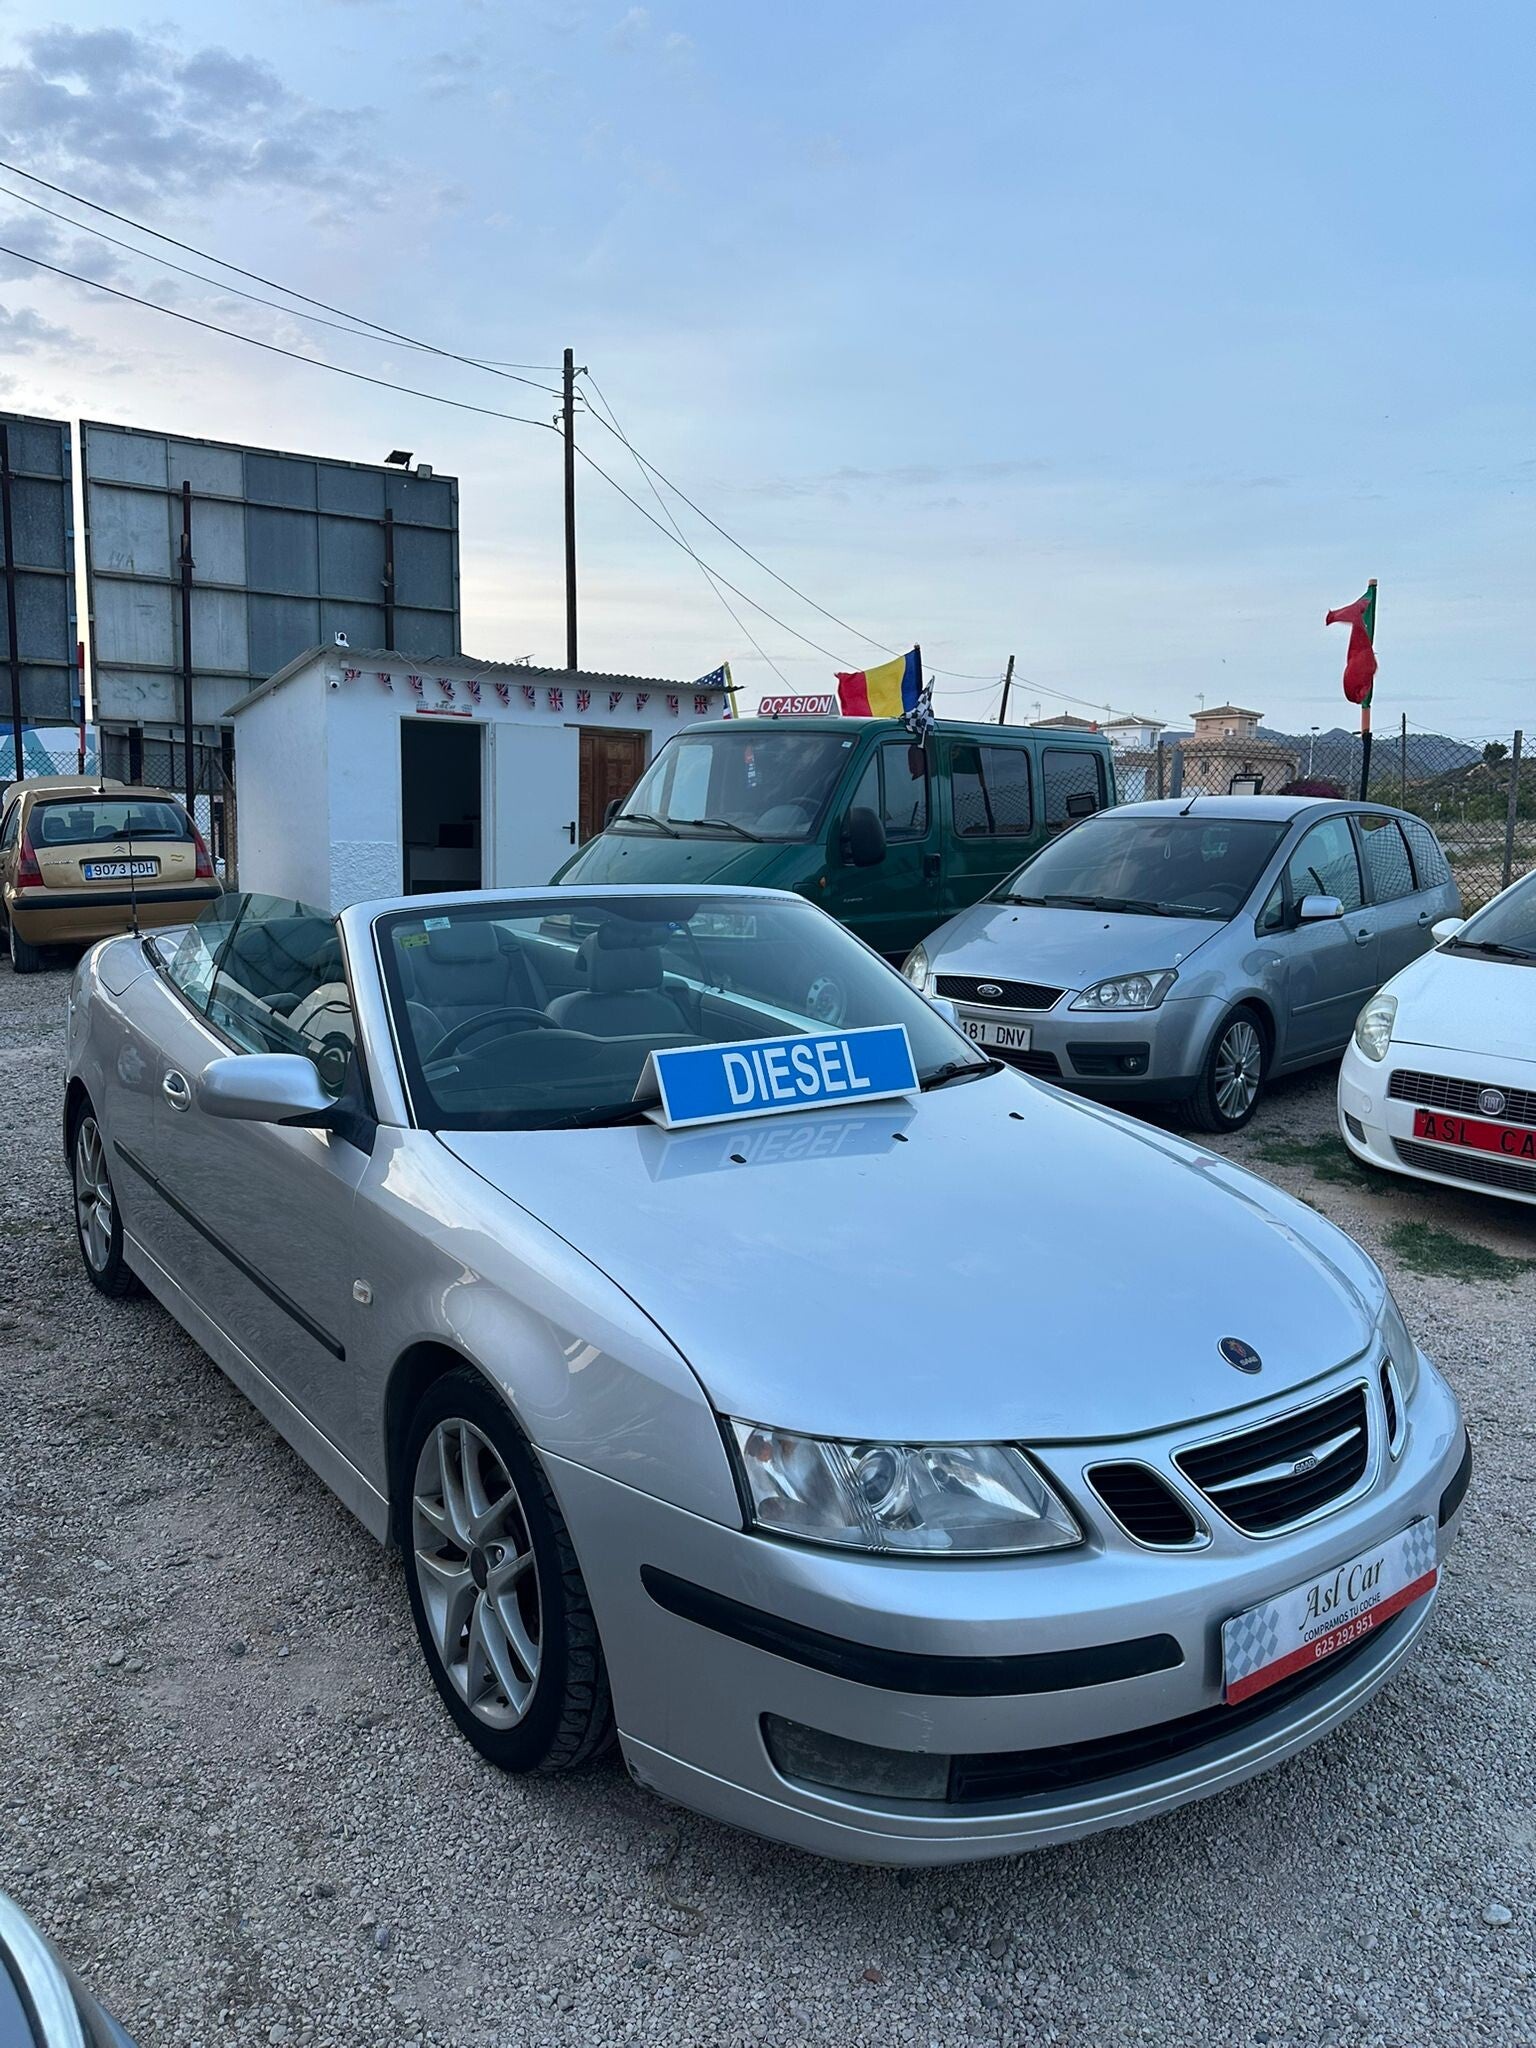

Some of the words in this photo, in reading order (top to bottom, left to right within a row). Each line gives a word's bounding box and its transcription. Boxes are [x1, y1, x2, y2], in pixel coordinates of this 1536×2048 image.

[760, 697, 830, 713] OCASION
[95, 864, 126, 876] 9073
[130, 863, 154, 874] CDH
[996, 1026, 1025, 1047] DNV
[722, 1041, 870, 1105] DIESEL
[1484, 1095, 1500, 1110] FIAT
[1424, 1116, 1472, 1146] ASL
[1501, 1130, 1535, 1157] CA
[1239, 1355, 1258, 1366] SAAB
[1295, 1457, 1316, 1474] SAAB
[1299, 1566, 1345, 1631] Asl
[1347, 1558, 1384, 1602] Car
[1303, 1610, 1349, 1643] COMPRAMOS
[1350, 1606, 1359, 1618] TU
[1360, 1592, 1381, 1612] COCHE
[1315, 1636, 1334, 1657] 625
[1336, 1625, 1355, 1646] 292
[1356, 1613, 1374, 1634] 951
